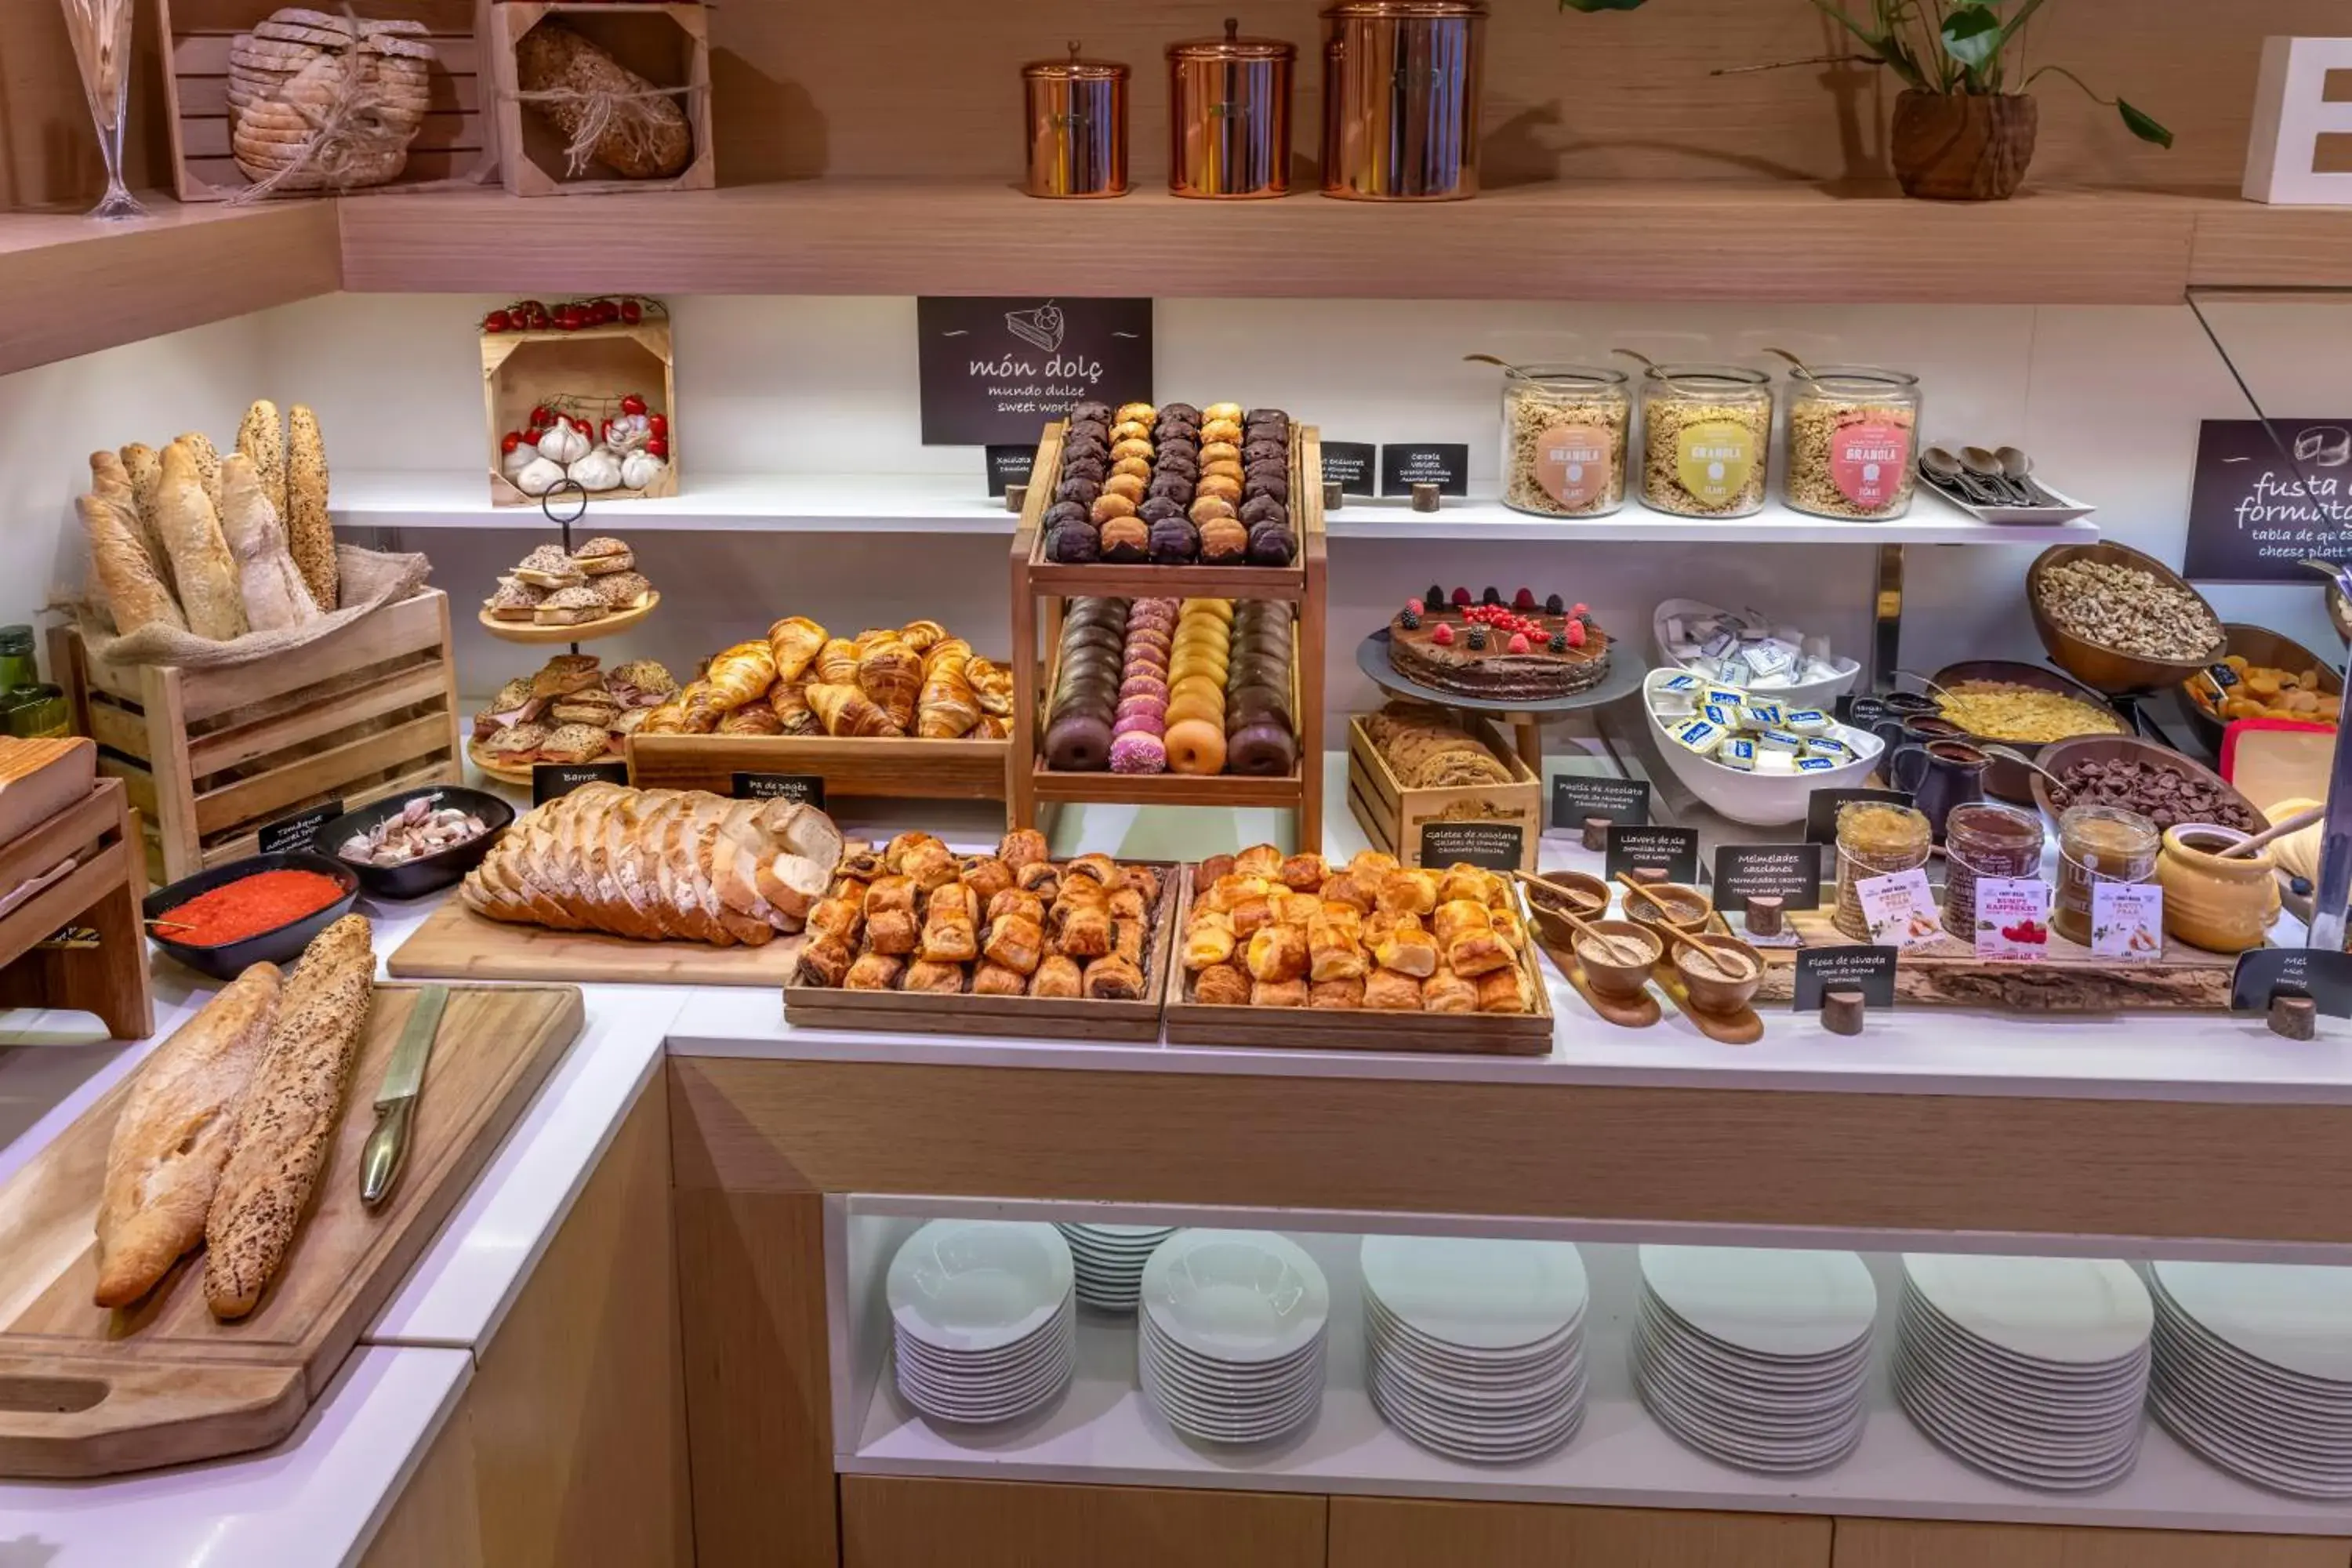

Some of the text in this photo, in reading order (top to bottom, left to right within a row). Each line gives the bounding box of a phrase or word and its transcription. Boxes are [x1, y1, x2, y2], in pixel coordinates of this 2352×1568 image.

[2268, 37, 2352, 204] E
[970, 354, 1103, 383] món dolç
[988, 384, 1086, 396] mundo dulce
[997, 401, 1035, 412] sweet
[1845, 448, 1896, 461] GRANOLA
[2253, 472, 2337, 503] fusta
[2252, 528, 2291, 541] tabla
[2295, 528, 2314, 541] de
[2259, 546, 2305, 557] cheese
[1621, 835, 1656, 844] Llavors
[1657, 835, 1669, 844] de
[1738, 853, 1800, 863] Melmelades
[1835, 956, 1848, 965] de
[2284, 957, 2307, 966] Mel
